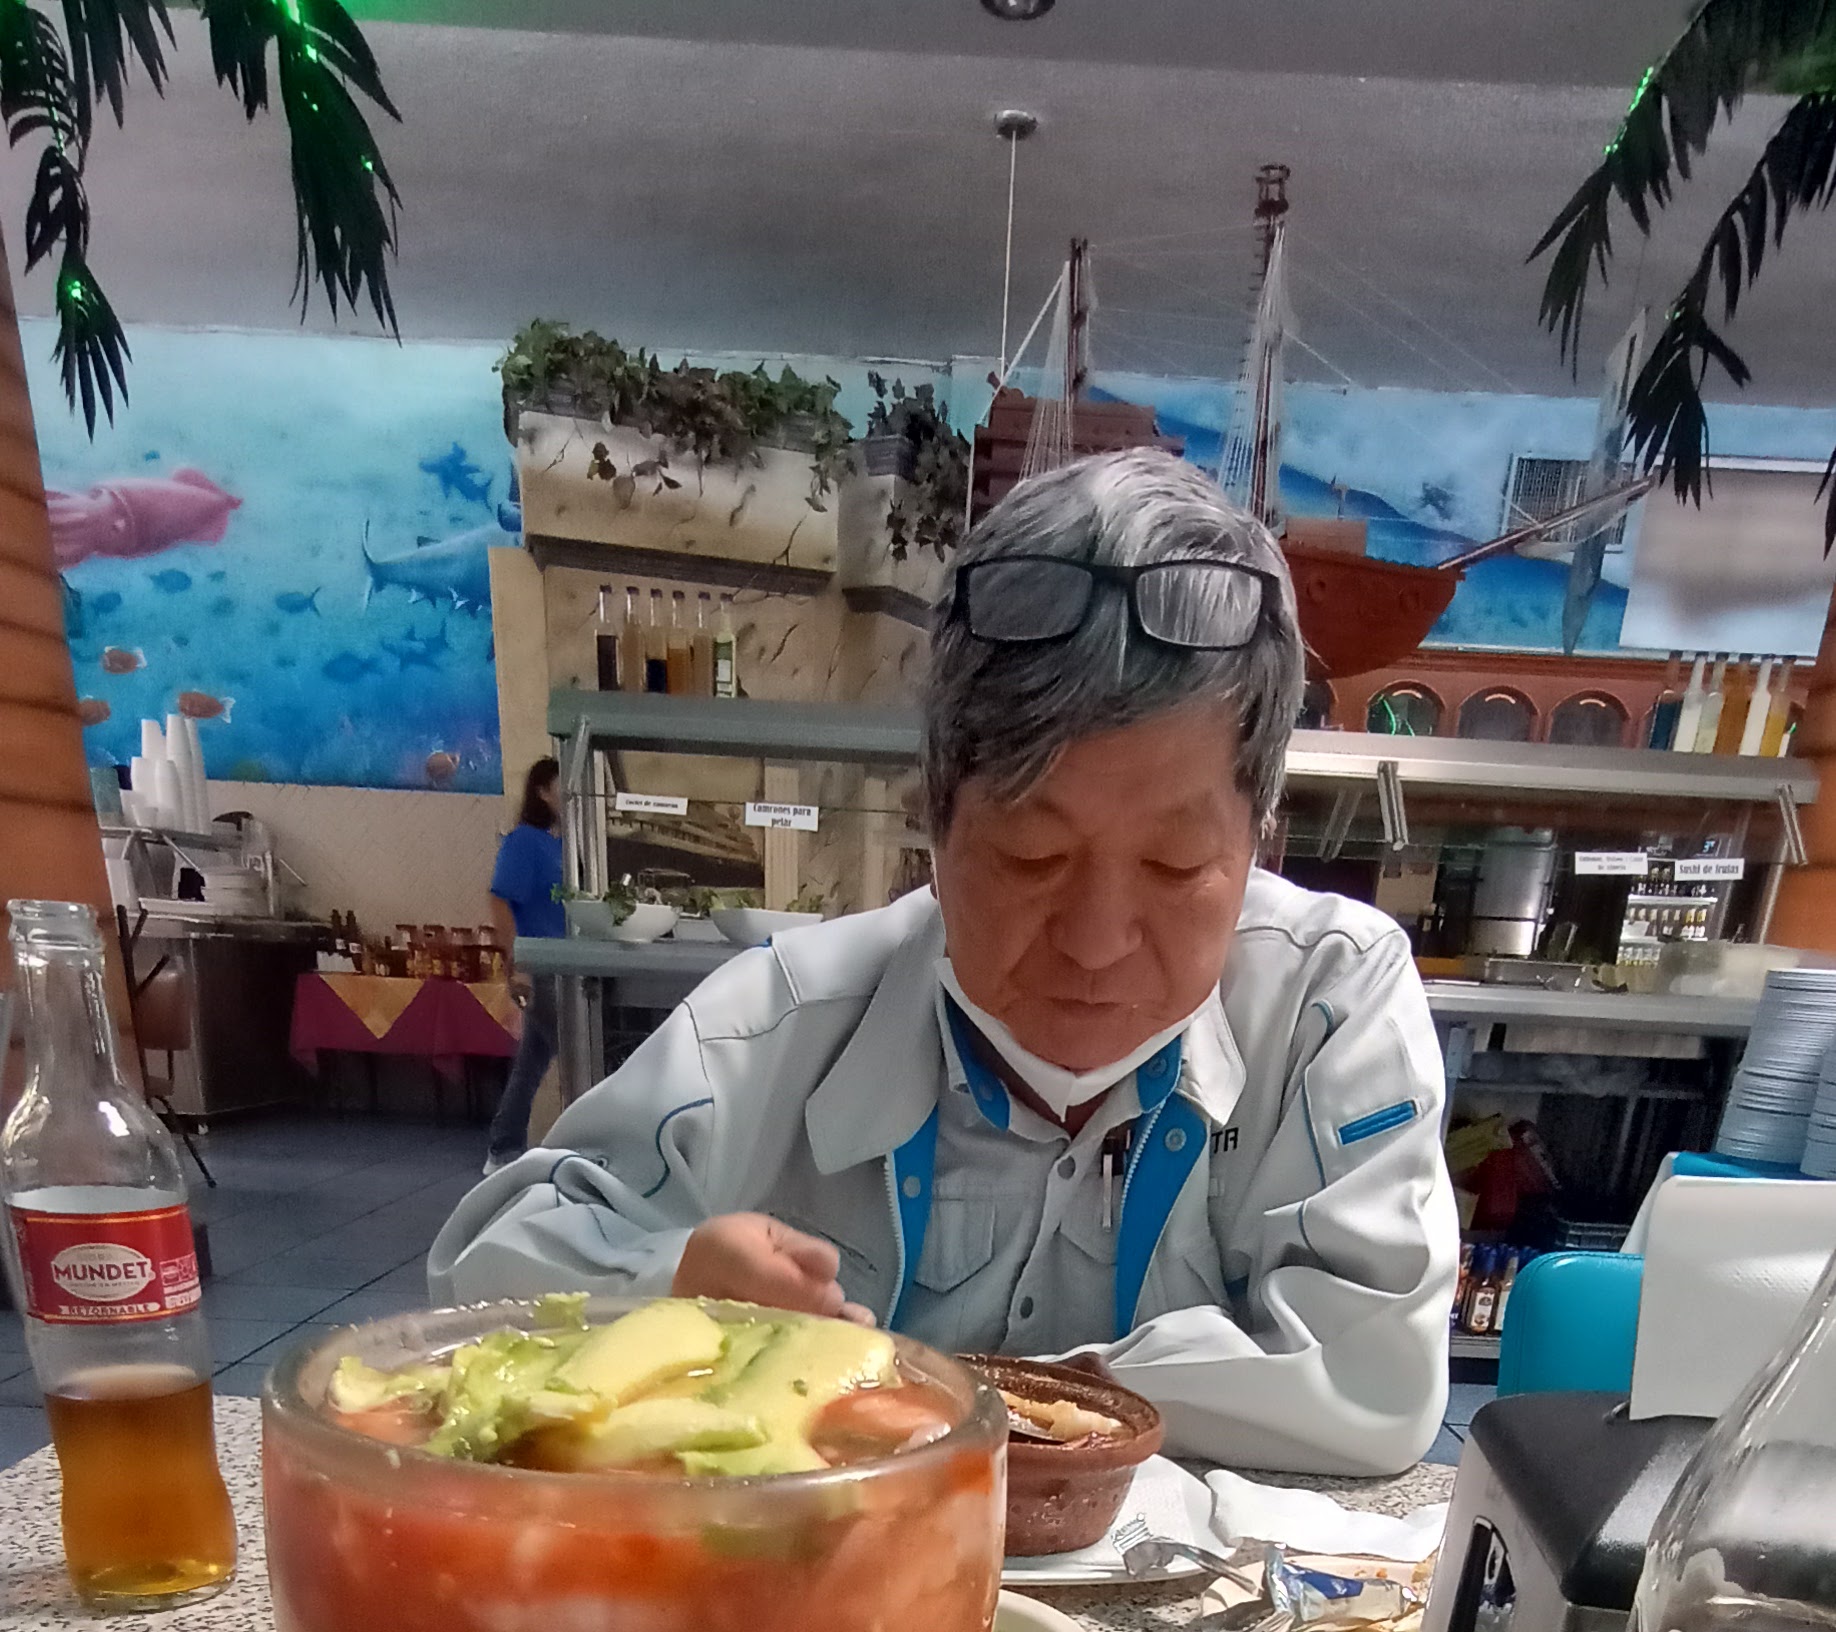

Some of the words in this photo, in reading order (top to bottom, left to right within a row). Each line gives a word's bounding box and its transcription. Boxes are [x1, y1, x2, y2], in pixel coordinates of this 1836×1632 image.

[793, 807, 812, 817] para
[771, 817, 792, 828] pelar
[1702, 864, 1713, 874] de
[54, 1261, 148, 1281] MUNDET
